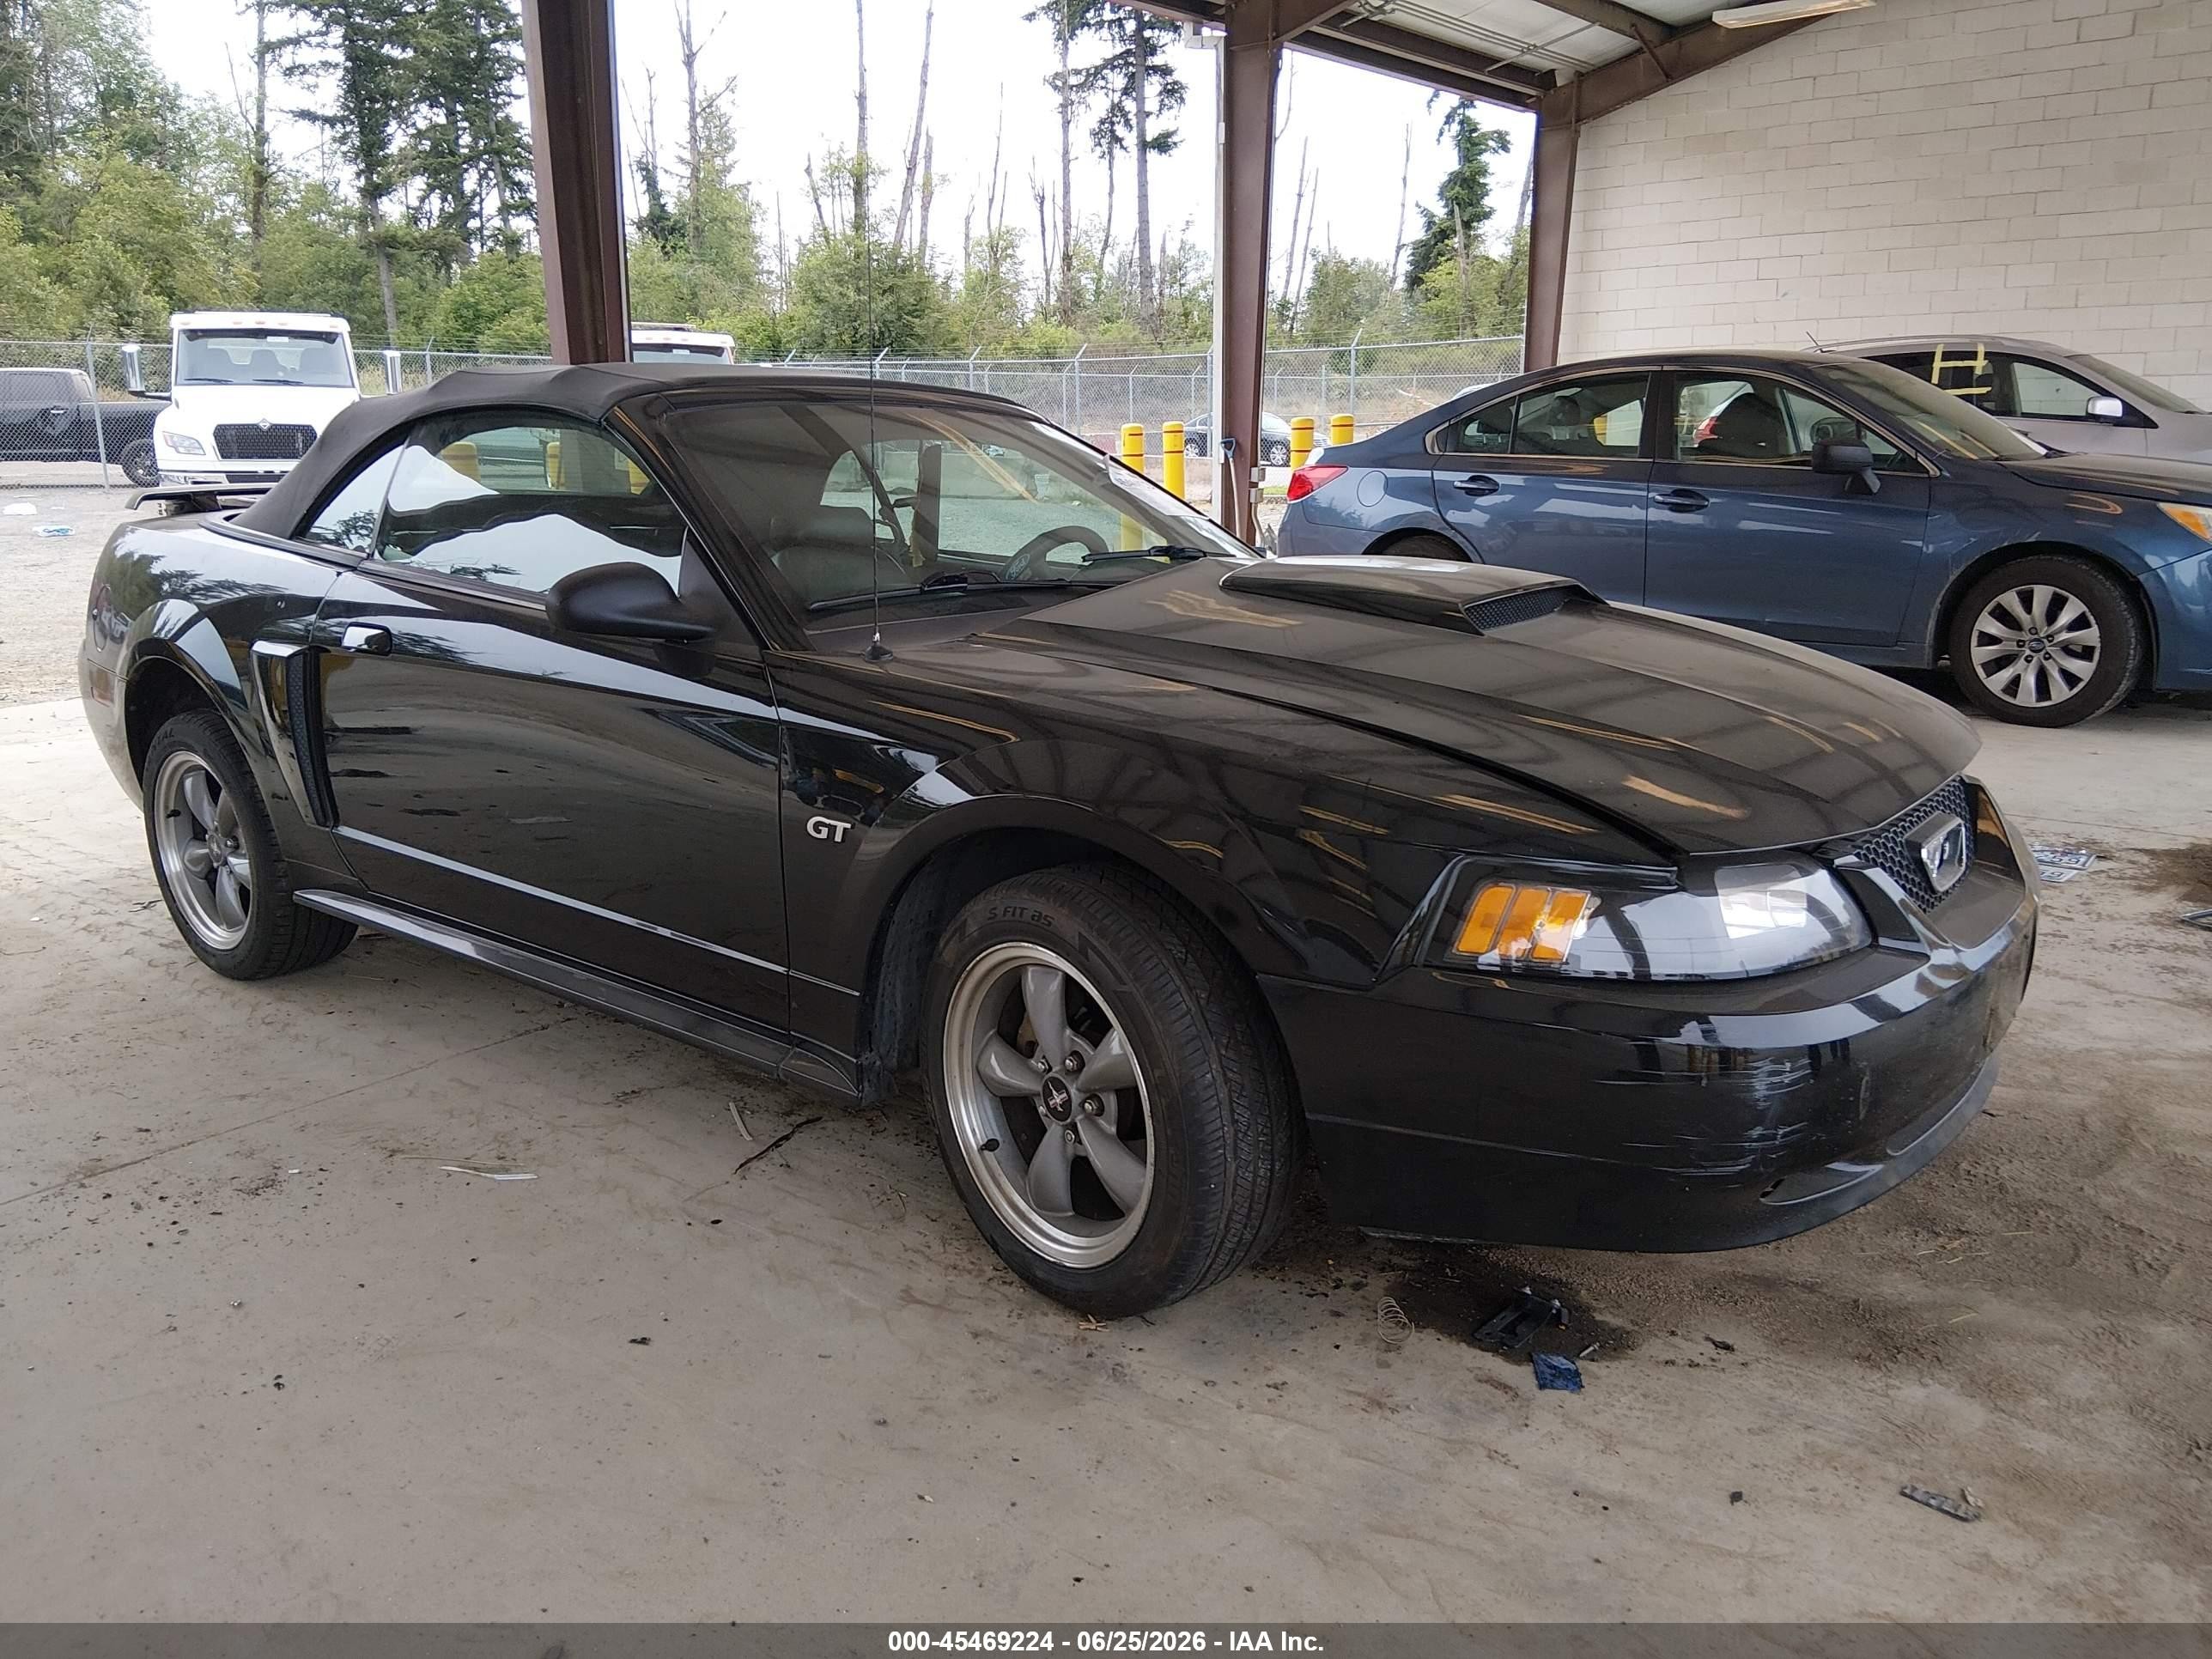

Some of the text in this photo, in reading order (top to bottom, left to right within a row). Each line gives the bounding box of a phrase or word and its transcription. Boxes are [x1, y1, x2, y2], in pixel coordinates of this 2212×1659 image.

[806, 816, 852, 842] GT
[988, 906, 998, 921] S
[1002, 906, 1029, 919] FIT
